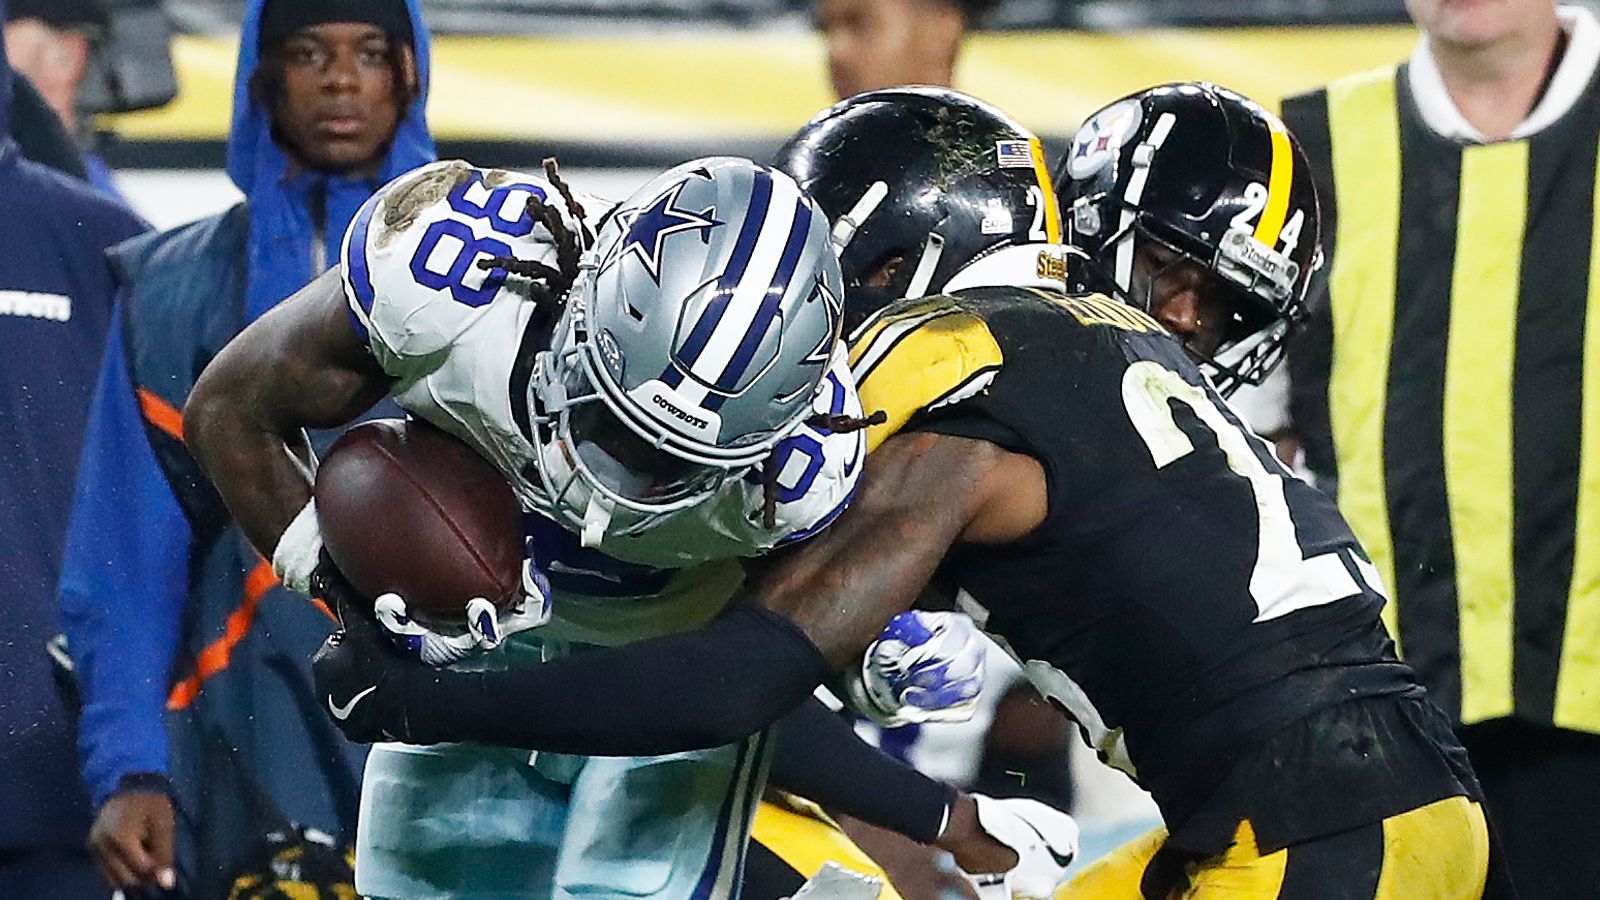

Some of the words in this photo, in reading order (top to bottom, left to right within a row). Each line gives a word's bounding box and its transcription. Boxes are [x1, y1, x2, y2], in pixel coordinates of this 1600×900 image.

[1025, 185, 1047, 241] 2
[652, 394, 709, 429] COWBOYS
[1121, 361, 1387, 623] 2
